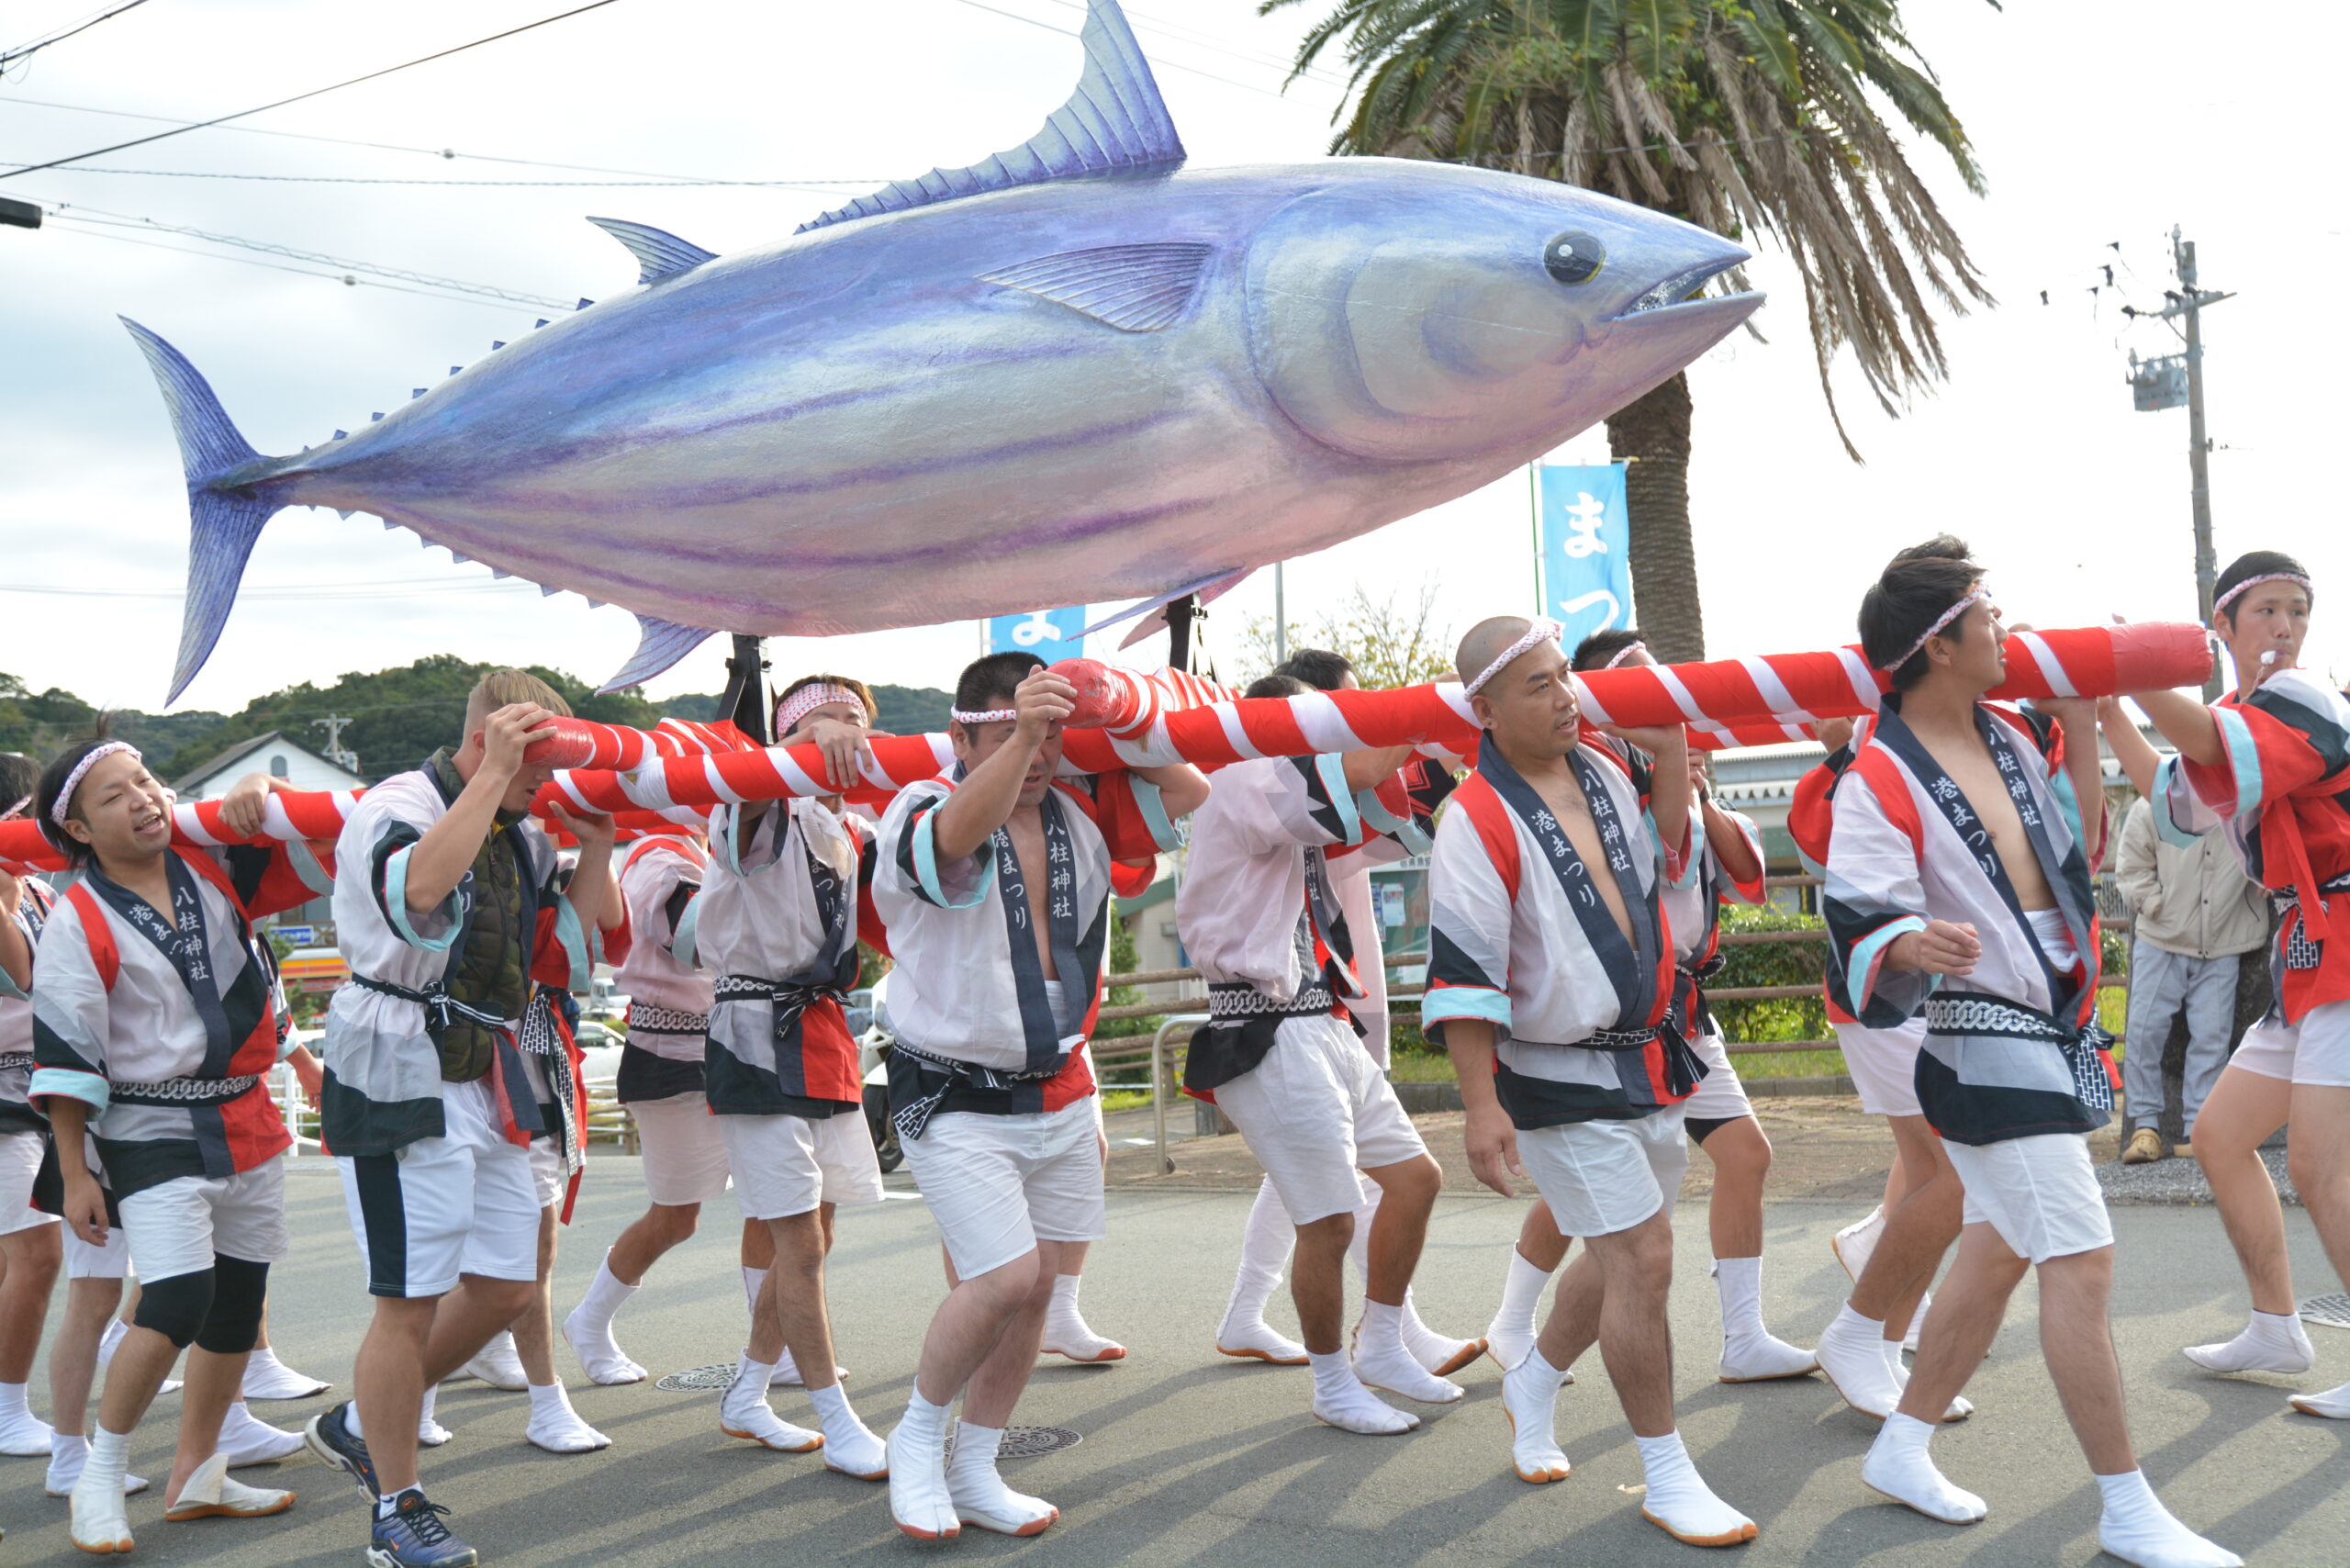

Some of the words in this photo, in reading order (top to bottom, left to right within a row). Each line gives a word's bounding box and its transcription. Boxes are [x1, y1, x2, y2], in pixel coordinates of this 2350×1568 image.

[1584, 768, 1631, 872] 八柱神社
[1988, 723, 2042, 826] 八柱神社
[1047, 816, 1072, 919] 八柱神社
[1531, 809, 1596, 907] 港まつり
[1931, 777, 1998, 878] 港まつり
[175, 887, 210, 981] 八柱神社
